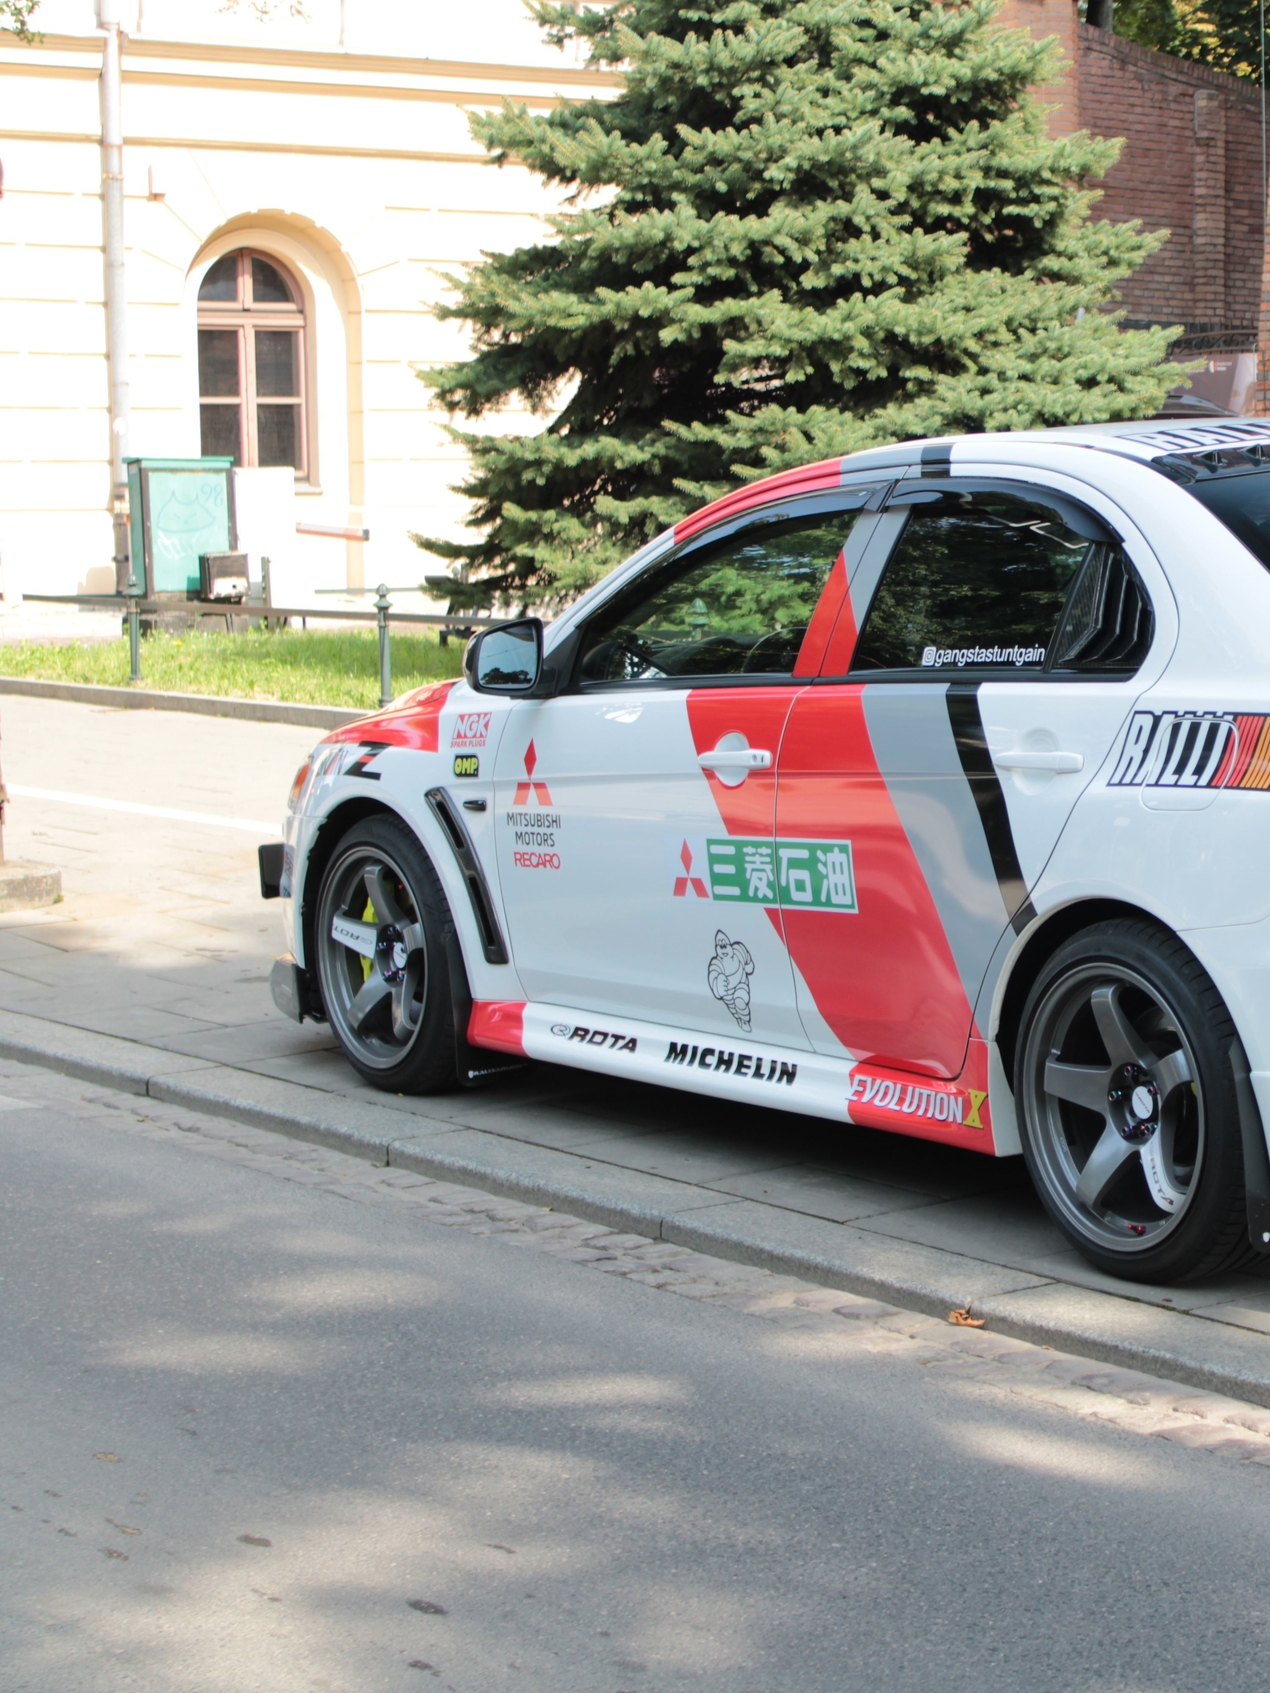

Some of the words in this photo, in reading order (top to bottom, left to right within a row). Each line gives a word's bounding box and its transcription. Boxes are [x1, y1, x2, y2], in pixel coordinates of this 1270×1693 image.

[453, 714, 491, 738] NGK
[451, 740, 467, 748] SPARK
[468, 739, 486, 747] PLUGS
[506, 812, 562, 829] MITSUBISHI
[515, 831, 556, 848] MOTORS
[513, 851, 562, 870] RECARO
[709, 845, 853, 905] 三菱石油
[334, 926, 360, 941] ROT
[569, 1026, 638, 1054] ROTA
[664, 1041, 797, 1086] MICHELIN
[845, 1074, 963, 1124] EVOLUTION
